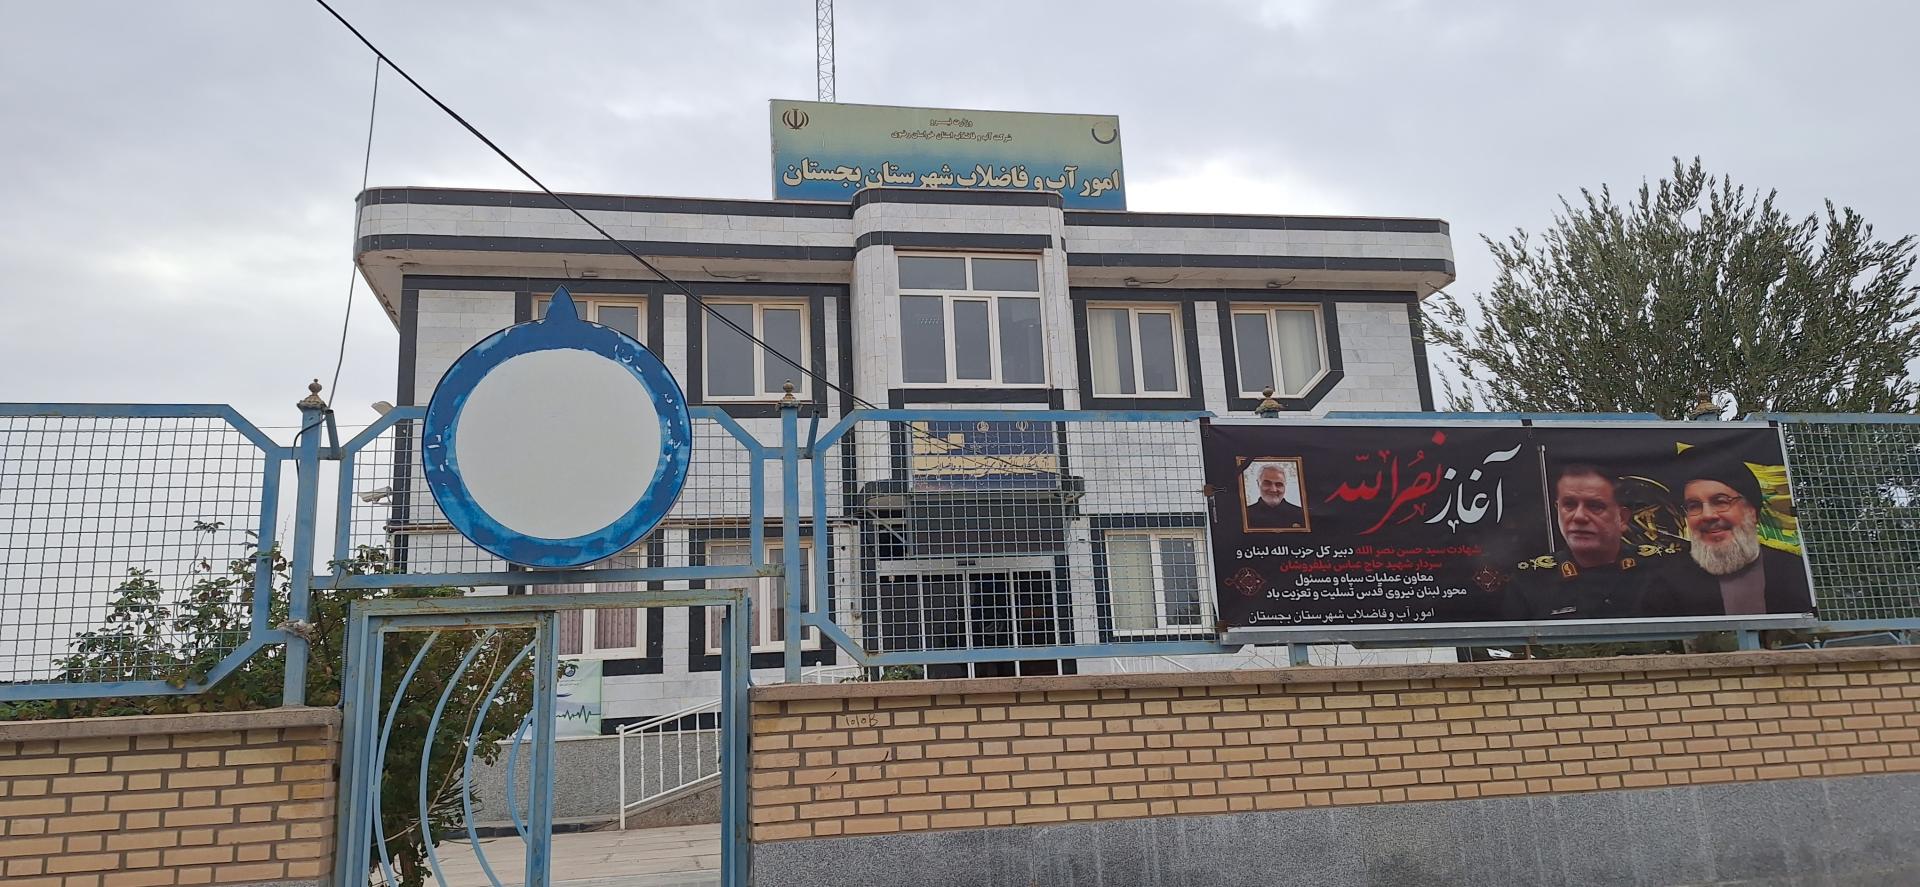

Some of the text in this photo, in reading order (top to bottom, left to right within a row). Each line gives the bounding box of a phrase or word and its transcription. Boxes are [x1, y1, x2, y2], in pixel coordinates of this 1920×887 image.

[891, 129, 912, 139] رضوی
[912, 130, 935, 140] خراسان
[936, 131, 953, 140] استان
[954, 131, 977, 141] فاضلاب
[982, 132, 992, 142] آب
[993, 132, 1013, 143] شرکت
[782, 157, 862, 189] بجستان
[956, 163, 1030, 190] فاضلاب
[1045, 165, 1078, 192] آب
[1033, 176, 1045, 192] و
[1079, 169, 1121, 197] امور
[1423, 442, 1522, 527] آغاز
[1236, 545, 1482, 559] شهادت سید حسن نصر الله دبیر کل حزب الله لبنان و
[1333, 560, 1362, 572] عباس
[1363, 560, 1382, 572] حاج
[1386, 559, 1413, 571] شهید
[1415, 560, 1443, 571] سردار
[1295, 572, 1434, 587] معاون عملیات سپاه و مسئول
[1267, 586, 1467, 601] محور لبنان نیروی قدس تسلیت و تعزیت باد
[1248, 610, 1292, 624] بجستان
[1346, 608, 1387, 623] فاضلاب
[1387, 611, 1395, 621] و
[1396, 605, 1411, 622] آب
[1413, 607, 1435, 622] امور
